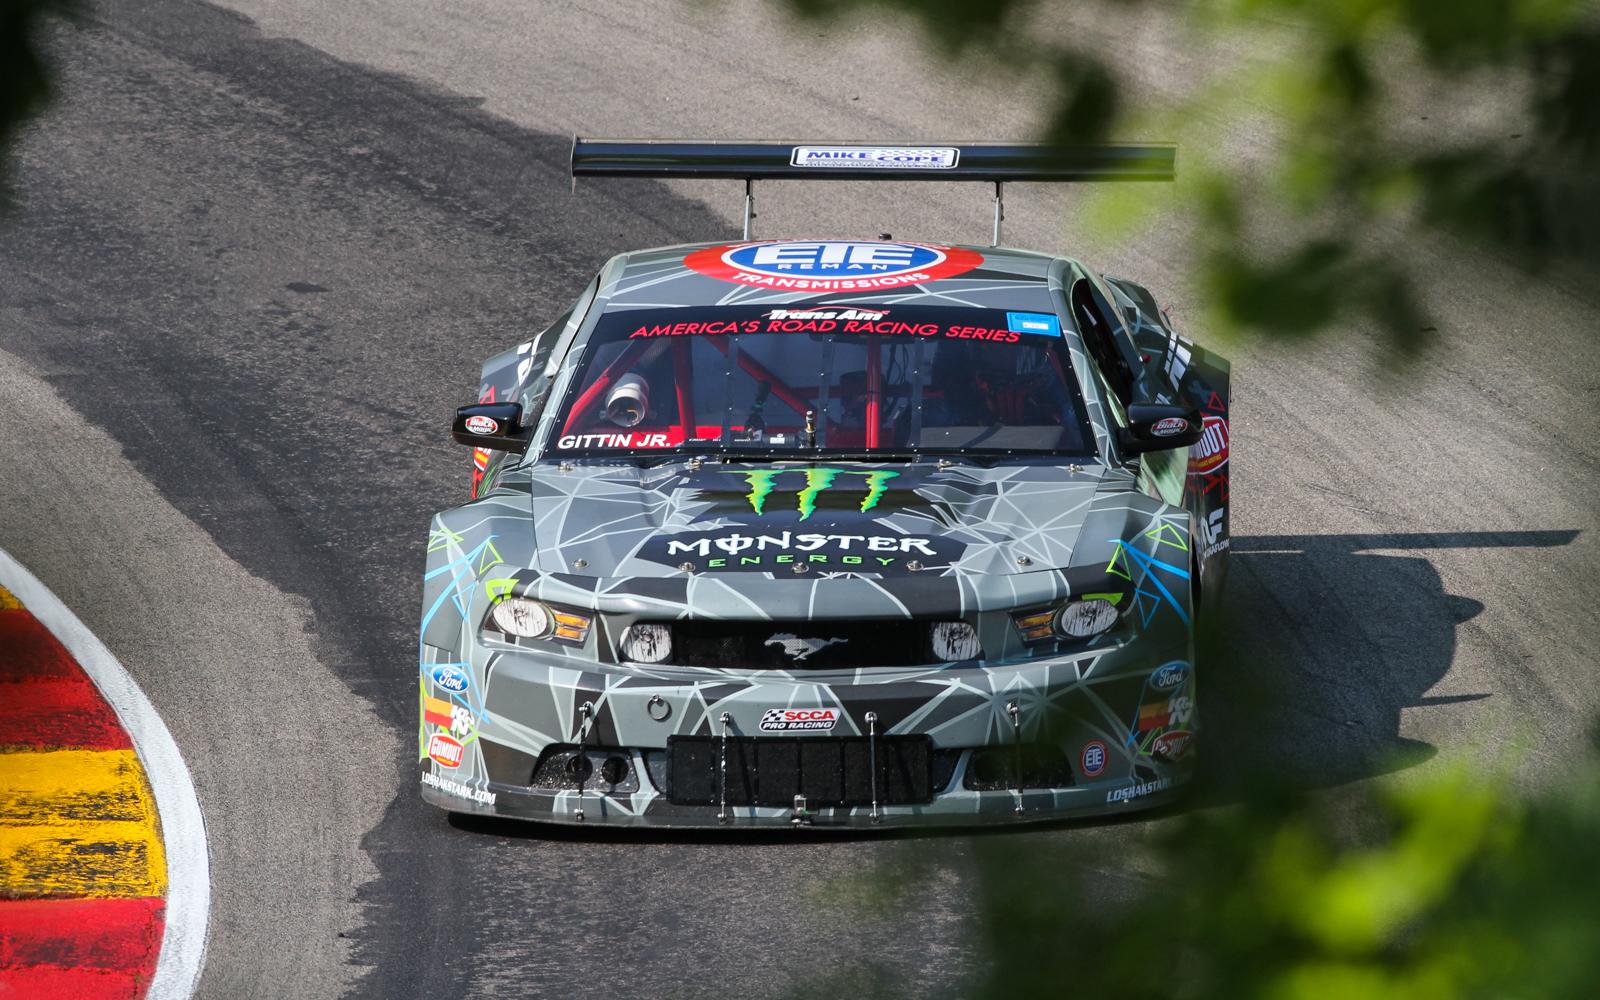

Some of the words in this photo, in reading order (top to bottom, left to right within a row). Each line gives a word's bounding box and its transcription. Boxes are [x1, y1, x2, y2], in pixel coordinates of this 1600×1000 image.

[807, 151, 873, 159] MIKE
[877, 155, 945, 163] COPE
[777, 263, 888, 271] REMAN
[733, 272, 930, 290] TRANSMISSIONS
[769, 309, 837, 320] Trans
[836, 309, 884, 320] Am
[629, 320, 761, 339] AMERICA'S
[766, 319, 838, 333] ROAD
[843, 321, 939, 336] RACING
[946, 325, 1021, 343] SERIES
[557, 433, 632, 449] GITTIN
[636, 434, 671, 447] JR.
[667, 531, 938, 556] MONSTER
[709, 554, 896, 568] ENERGY
[438, 668, 463, 690] Ford
[1158, 665, 1184, 687] Ford
[785, 710, 834, 721] SCCA
[763, 721, 786, 729] PRO
[788, 721, 832, 729] RACING
